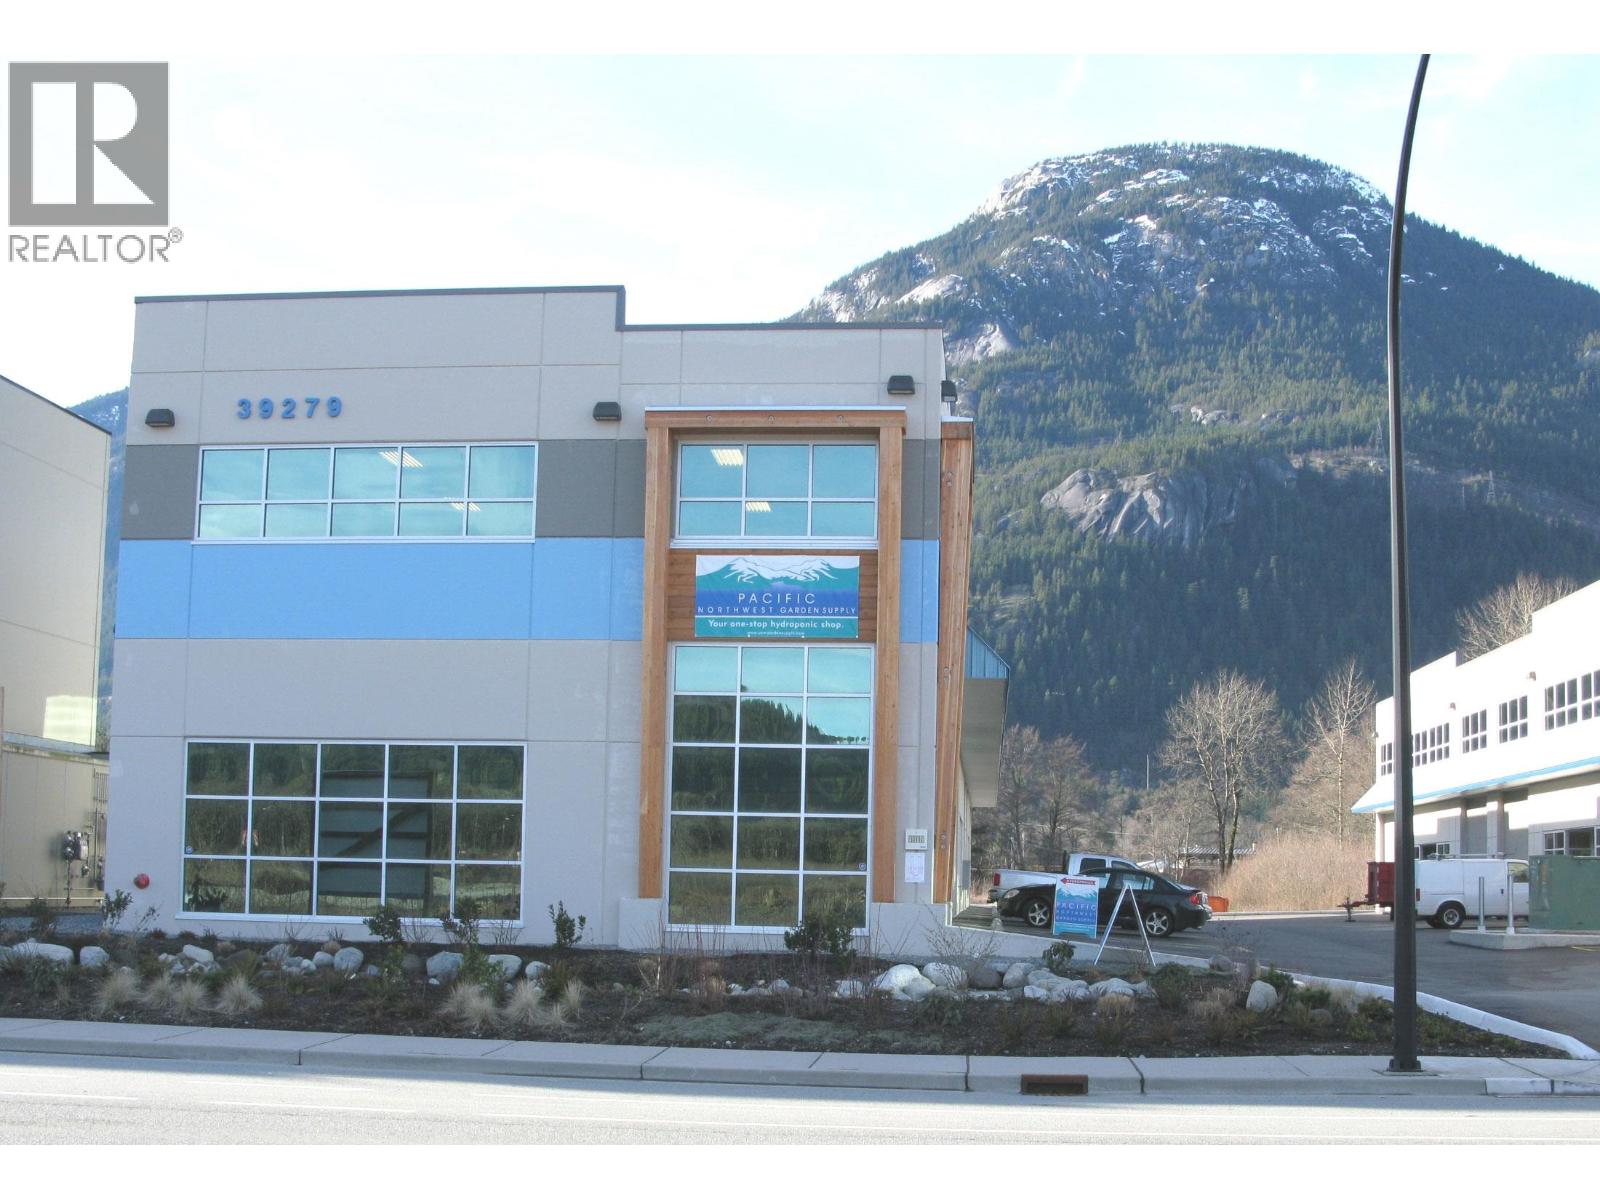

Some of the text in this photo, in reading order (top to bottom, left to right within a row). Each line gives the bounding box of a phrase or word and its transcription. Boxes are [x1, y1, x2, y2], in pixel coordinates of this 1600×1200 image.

[237, 396, 342, 420] 39279
[738, 592, 816, 605] PACIFIC
[698, 606, 773, 614] NORTHWEST
[708, 619, 727, 628] Your
[730, 620, 768, 630] one-stop
[770, 619, 818, 630] hydroponic
[1056, 902, 1096, 911] PACIFIC
